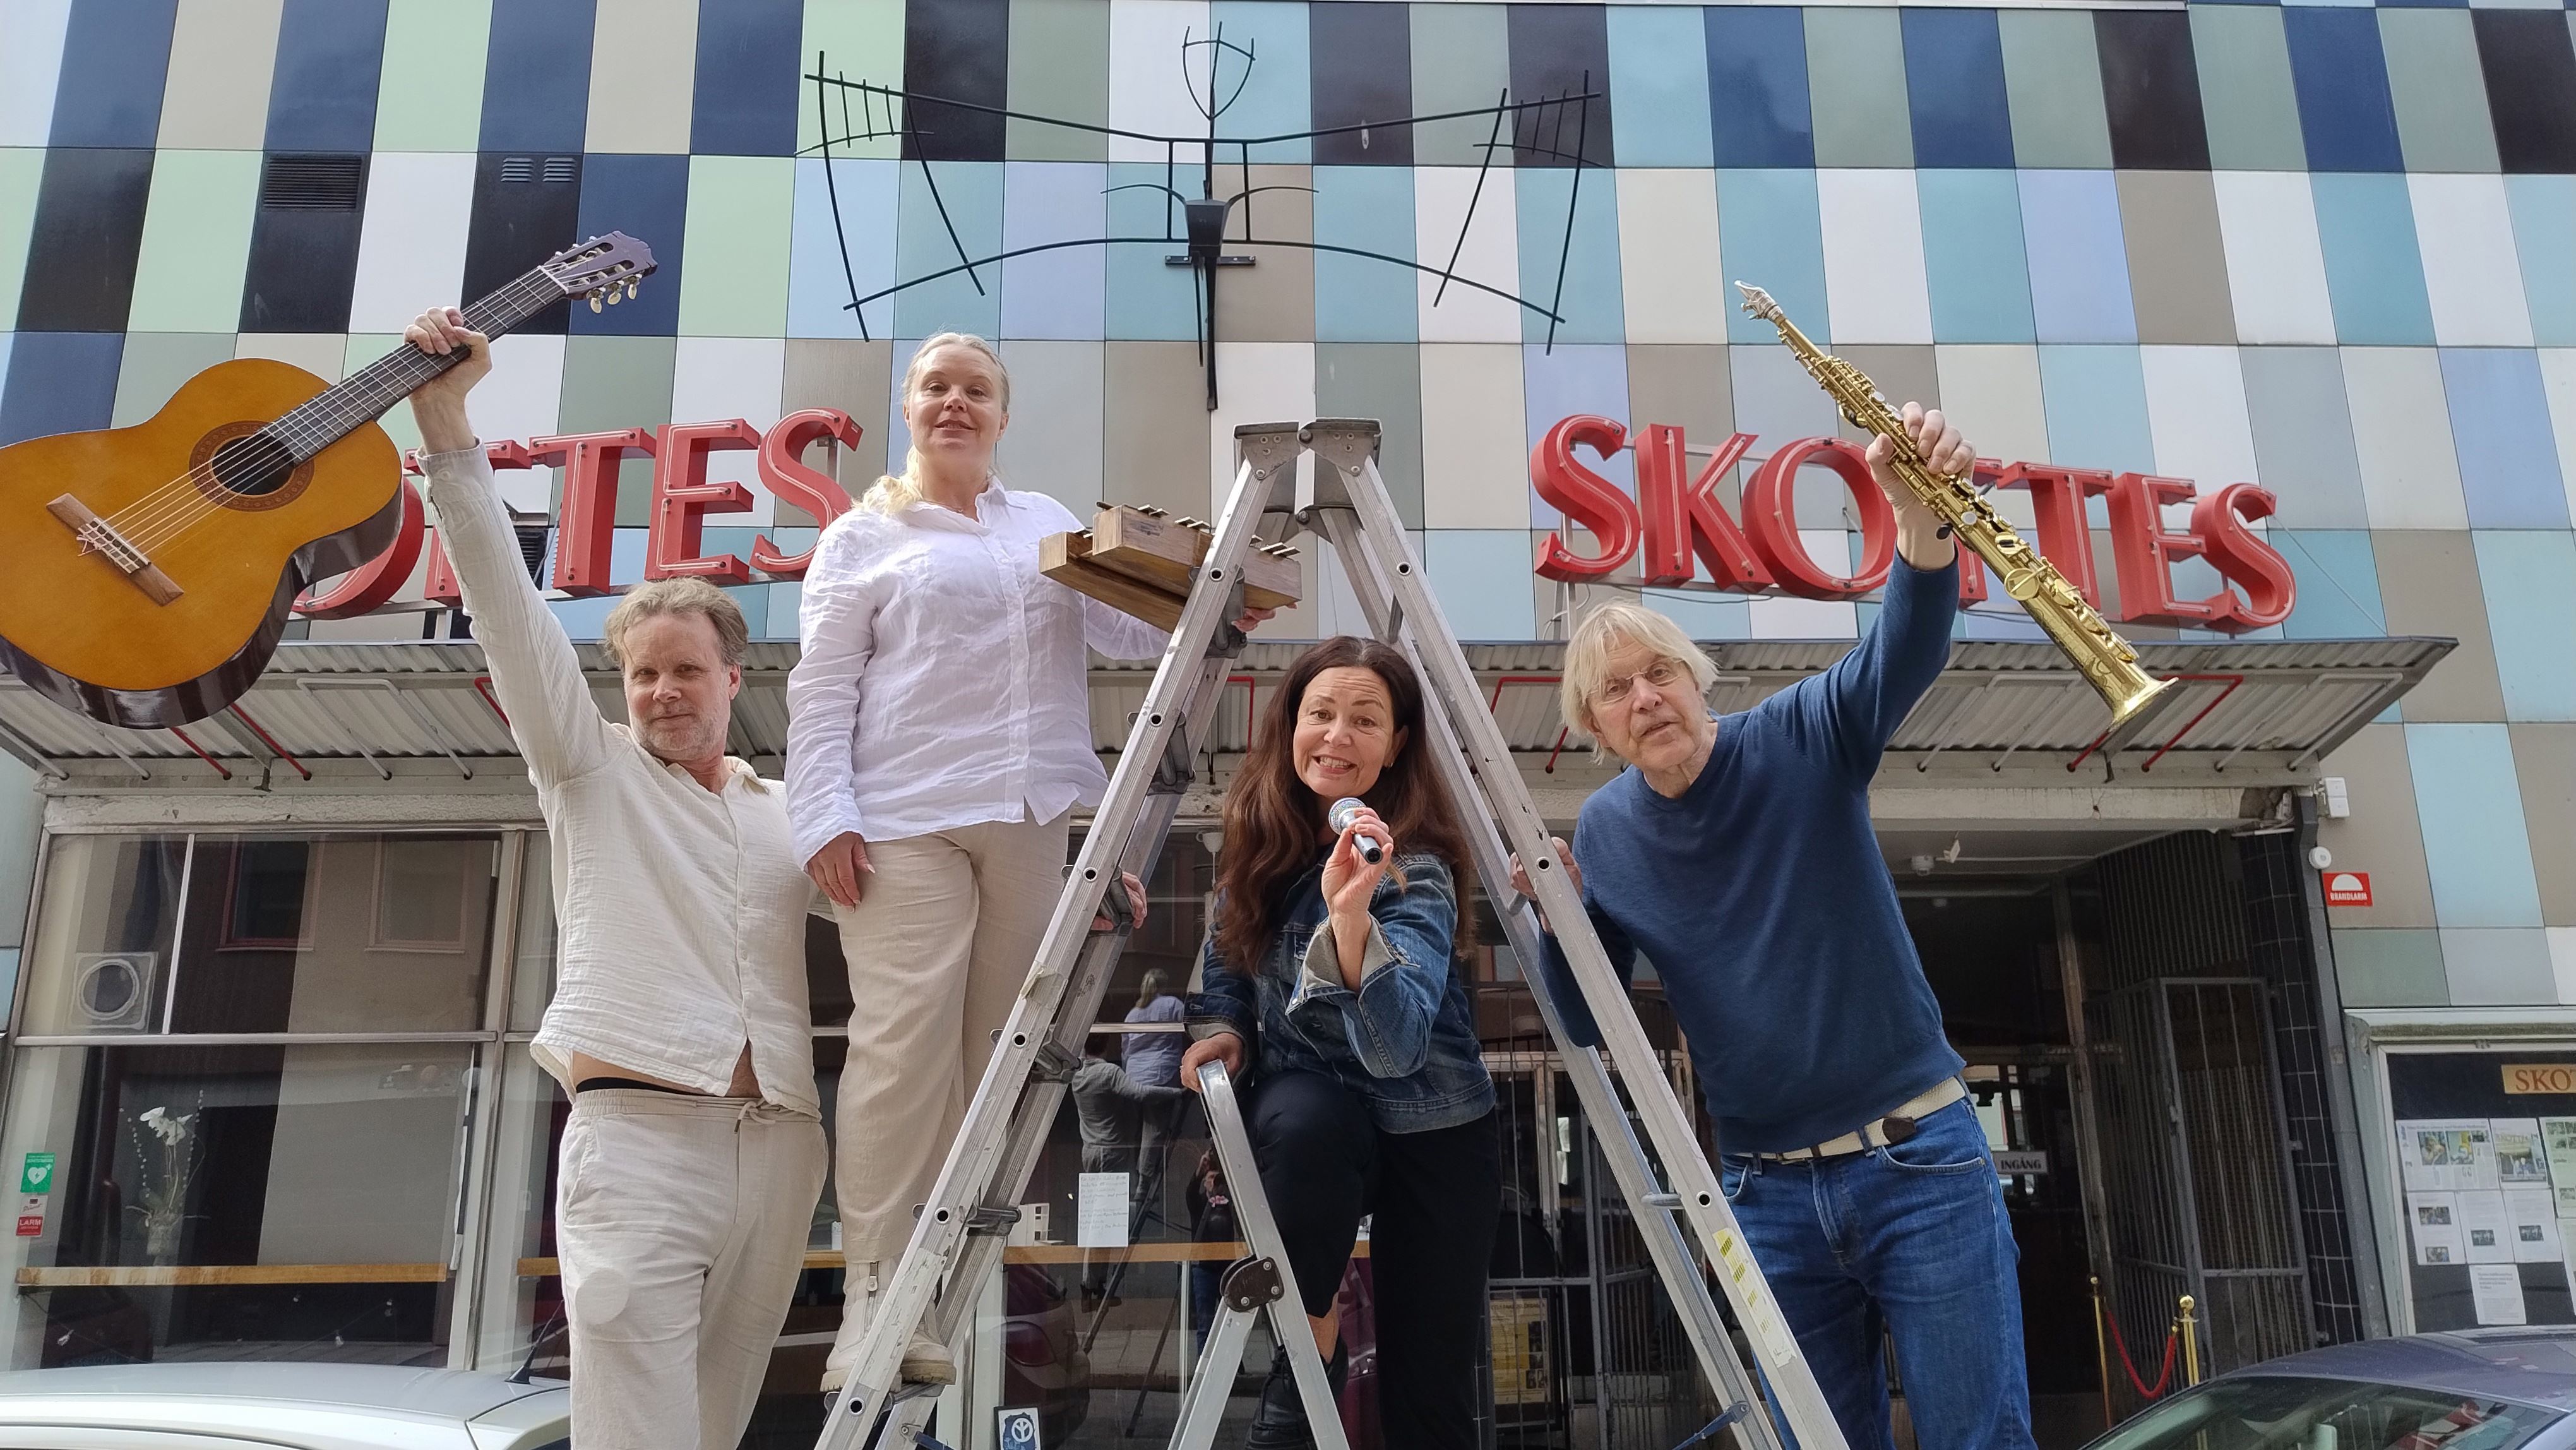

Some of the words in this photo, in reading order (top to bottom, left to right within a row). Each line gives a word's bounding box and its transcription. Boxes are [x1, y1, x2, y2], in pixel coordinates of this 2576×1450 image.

[2330, 892, 2368, 901] BRANDLARM
[2515, 1069, 2576, 1091] SKO
[2001, 1156, 2042, 1169] INGÅNG
[19, 1218, 42, 1226] LARM
